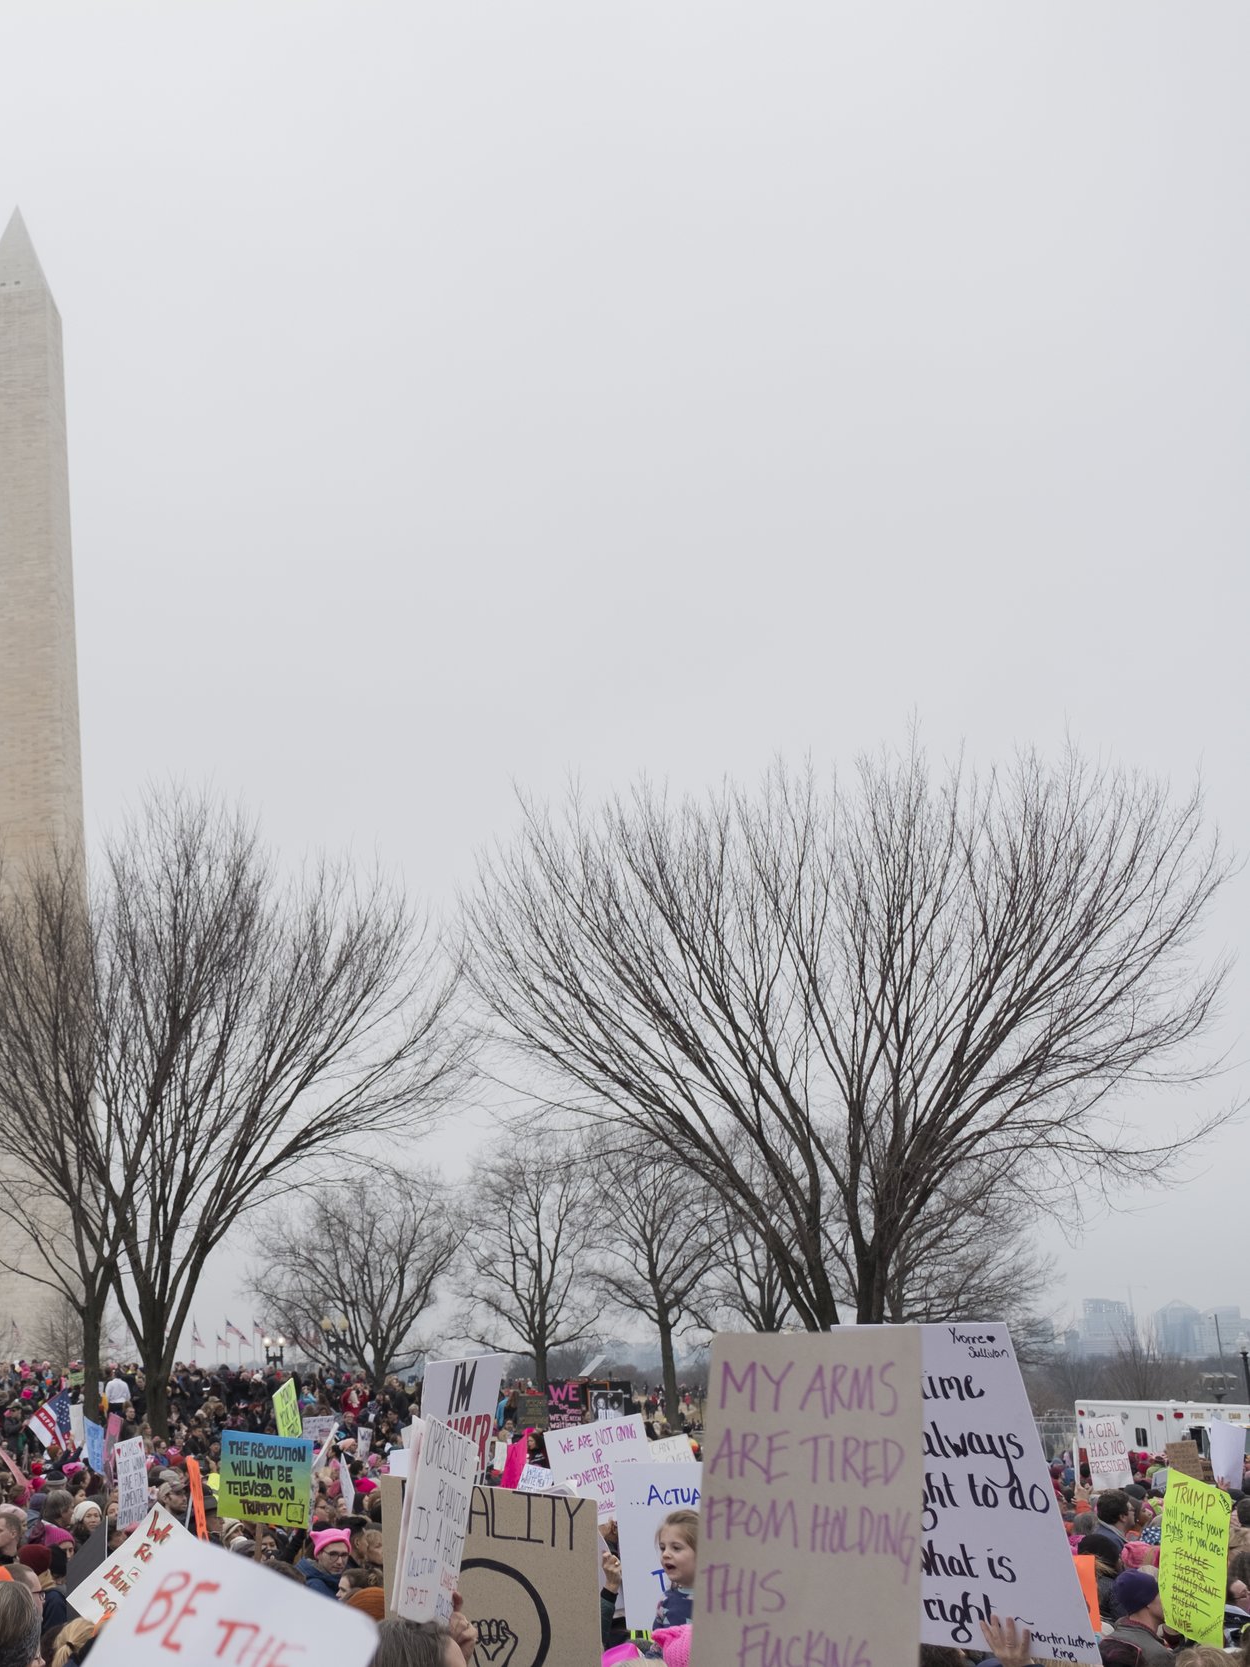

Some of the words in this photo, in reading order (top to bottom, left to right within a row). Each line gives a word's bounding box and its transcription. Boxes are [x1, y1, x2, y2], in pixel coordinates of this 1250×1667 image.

[967, 1346, 1011, 1360] Sullivan
[447, 1360, 478, 1416] I'M
[548, 1383, 580, 1401] WE
[719, 1360, 796, 1414] MY
[799, 1360, 900, 1420] ARMS
[558, 1437, 575, 1455] WE
[577, 1433, 593, 1450] ARE
[594, 1425, 615, 1447] NOT
[1088, 1424, 1096, 1439] A
[1095, 1421, 1120, 1438] GIRL
[228, 1440, 250, 1456] THE
[250, 1442, 306, 1462] REVOLUTION
[591, 1448, 604, 1465] UP
[709, 1427, 791, 1486] ARE
[798, 1433, 906, 1489] TIRED
[1089, 1441, 1109, 1458] HAS
[1110, 1440, 1126, 1457] NO
[231, 1460, 256, 1477] WILL
[257, 1461, 275, 1480] NOT
[277, 1465, 293, 1483] BE
[581, 1463, 614, 1487] NEITHER
[1089, 1457, 1131, 1475] PRESIDENT
[278, 1486, 295, 1501] ON
[597, 1479, 616, 1497] YOU
[922, 1471, 961, 1532] ght
[967, 1472, 1000, 1509] to
[1008, 1472, 1051, 1515] do
[1172, 1481, 1216, 1515] TRUMP
[414, 1506, 432, 1542] IS
[466, 1486, 587, 1551] ALITY
[1165, 1505, 1178, 1521] will
[1180, 1510, 1205, 1532] protect
[1206, 1522, 1225, 1540] your
[704, 1495, 800, 1551] FROM
[810, 1502, 917, 1587] HOLDING
[1187, 1530, 1195, 1548] if
[1209, 1541, 1225, 1557] are:
[986, 1547, 1018, 1585] is
[1173, 1547, 1210, 1571] FEMALE
[1173, 1561, 1206, 1583] LGBTQ
[701, 1562, 787, 1619] THIS
[1172, 1572, 1222, 1599] IMMIGRANT
[135, 1571, 220, 1653] BE
[1171, 1603, 1192, 1620] RICH
[216, 1619, 307, 1667] THE
[736, 1621, 873, 1667] FUCKING
[1031, 1631, 1067, 1647] Martin
[1068, 1634, 1097, 1650] Luther
[1052, 1646, 1078, 1664] King
